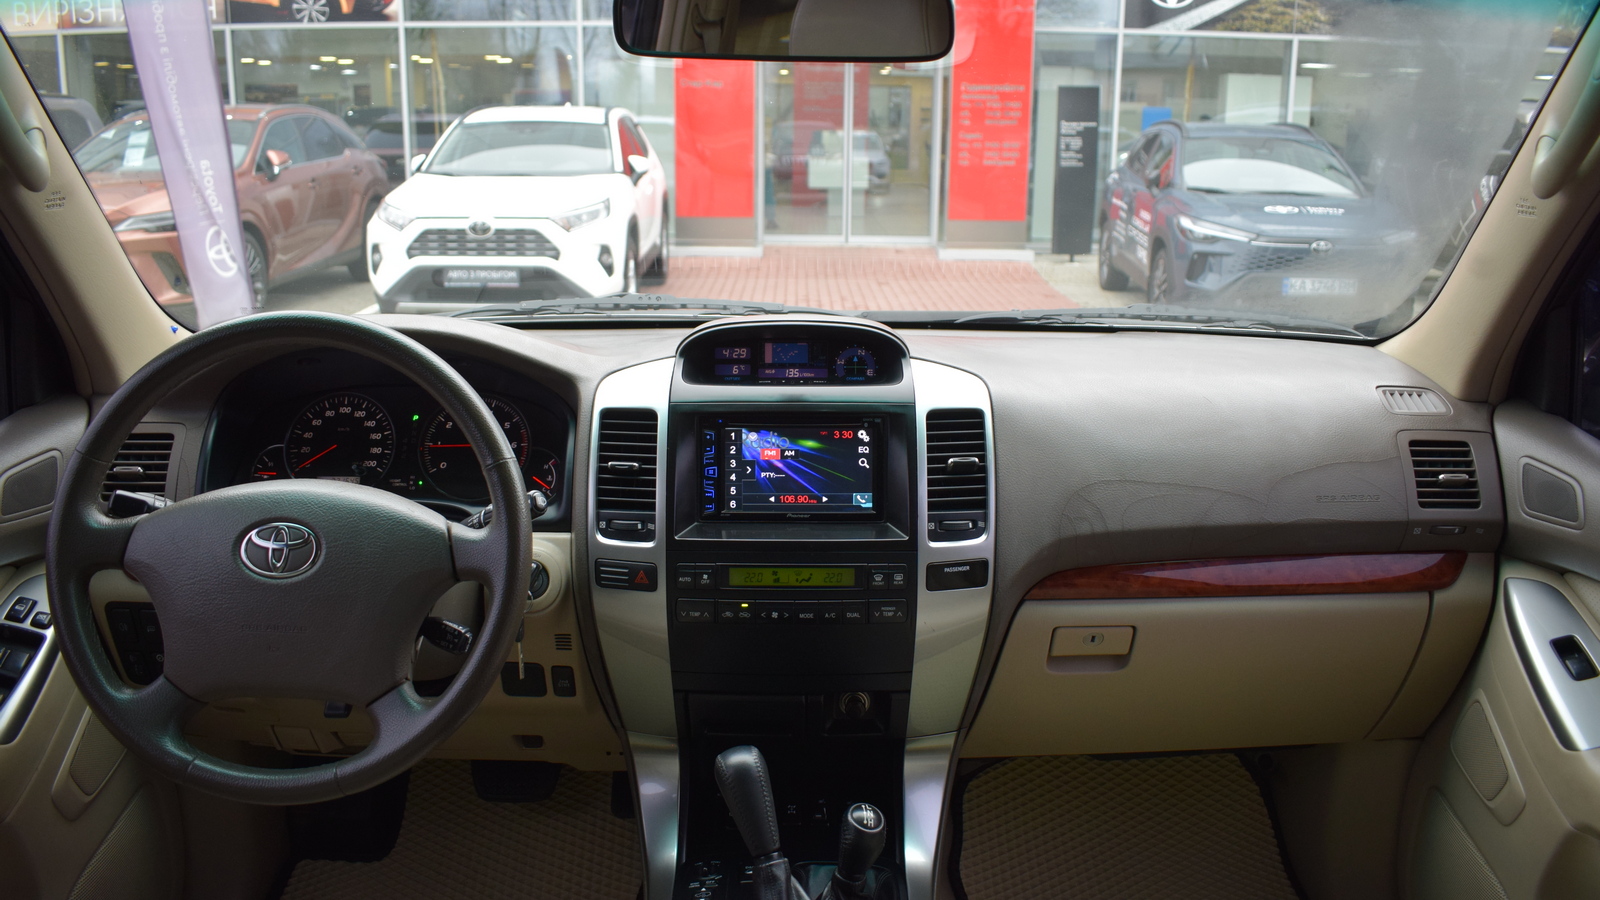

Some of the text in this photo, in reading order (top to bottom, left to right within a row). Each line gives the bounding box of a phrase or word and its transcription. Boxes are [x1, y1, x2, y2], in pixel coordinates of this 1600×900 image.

[722, 348, 747, 359] 4:29
[732, 365, 739, 375] 6
[445, 421, 453, 429] 2
[504, 421, 511, 429] 5
[730, 432, 736, 441] 1
[511, 441, 518, 449] 6
[729, 445, 737, 455] 2
[858, 446, 870, 454] EQ
[439, 461, 447, 469] 0
[729, 459, 737, 468] 3
[729, 473, 737, 482] 4
[729, 486, 737, 496] 5
[779, 495, 809, 504] 106.90
[1340, 494, 1381, 502] AIRBAG
[729, 500, 737, 509] 6
[944, 565, 970, 573] PASSENGER
[743, 572, 763, 583] 22.0
[823, 572, 843, 583] 22.0
[868, 818, 874, 827] H
